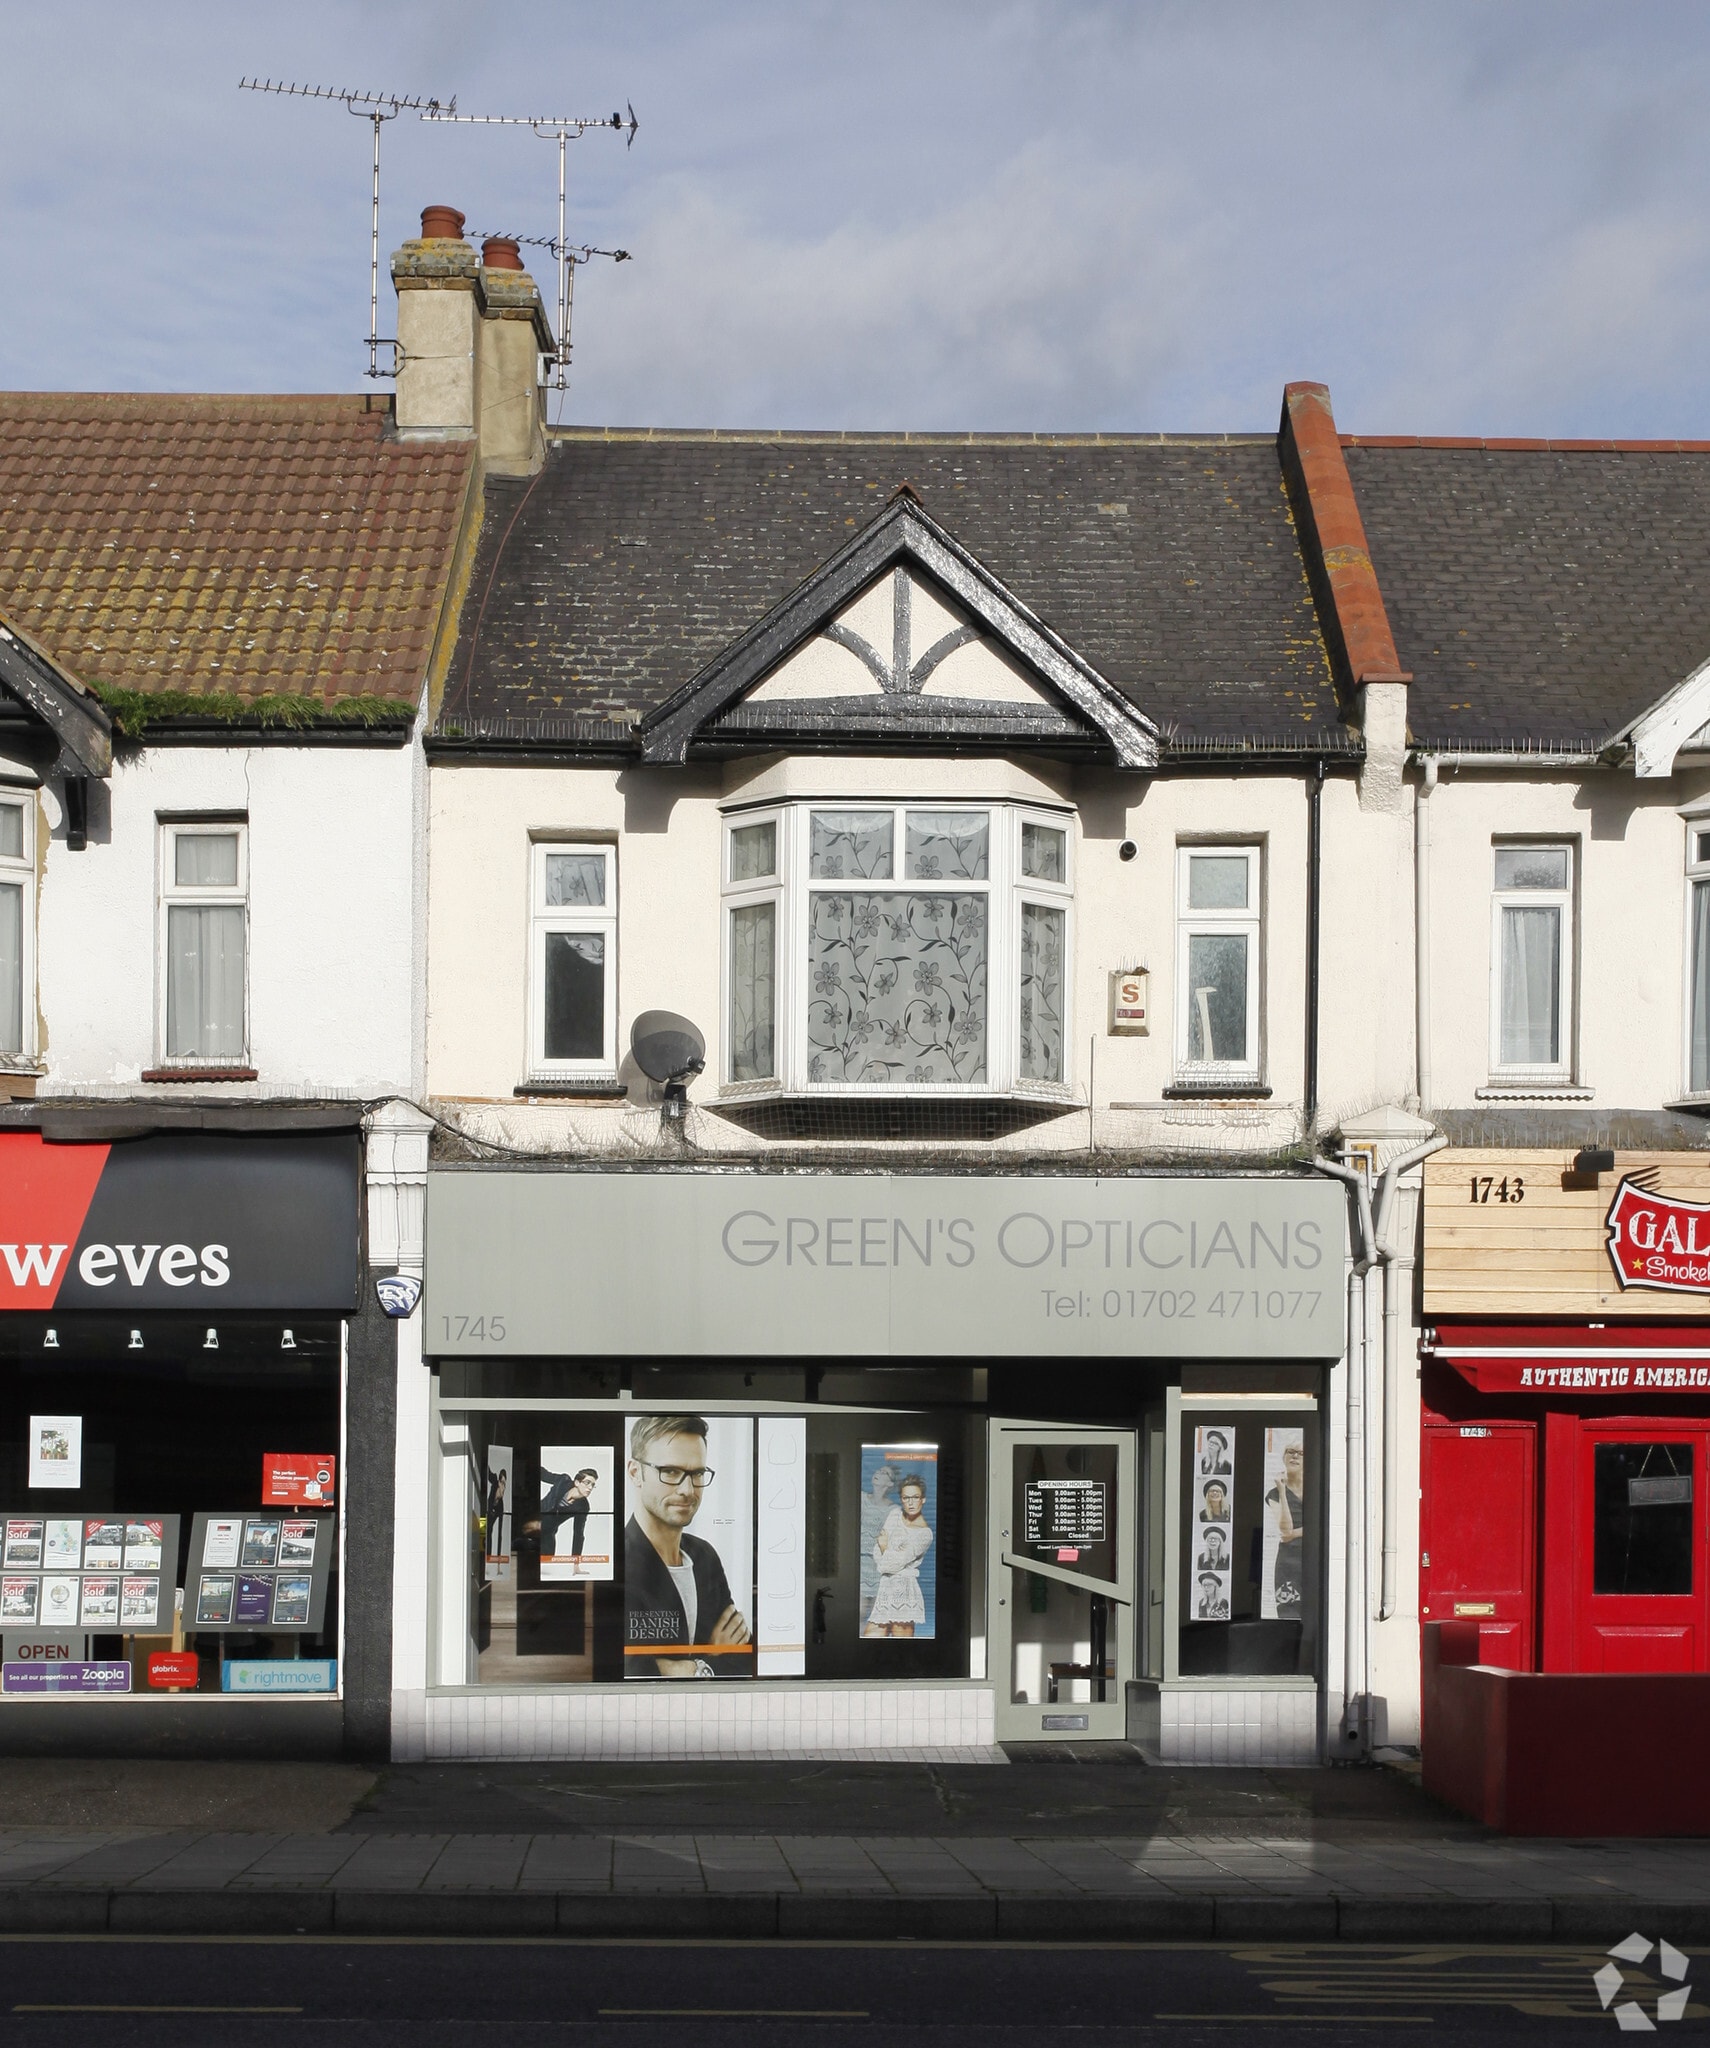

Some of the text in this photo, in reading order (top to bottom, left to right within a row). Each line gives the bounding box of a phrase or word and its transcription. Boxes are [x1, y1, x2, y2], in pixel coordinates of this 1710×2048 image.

[1122, 984, 1139, 1003] S
[1469, 1176, 1524, 1203] 1743
[722, 1210, 1323, 1269] GREEN'S OPTICIANS
[79, 1243, 230, 1287] eves
[1646, 1256, 1710, 1282] Smoke
[383, 1287, 414, 1300] ESS
[1041, 1290, 1322, 1319] Tel: 01702 471077
[442, 1315, 506, 1341] 1745
[1520, 1367, 1710, 1387] AUTHENTIC AMERIC
[8, 1530, 29, 1539] Sold
[283, 1529, 303, 1538] Sold
[3, 1587, 25, 1596] Sold
[84, 1587, 105, 1596] Sold
[124, 1587, 145, 1596] Sold
[629, 1610, 680, 1618] PRESENTING
[629, 1618, 680, 1628] DANISH
[629, 1628, 680, 1640] DESIGN
[18, 1645, 69, 1659] OPEN
[39, 1674, 69, 1682] properties
[82, 1668, 124, 1681] Zoopla
[254, 1671, 322, 1687] rightmove
